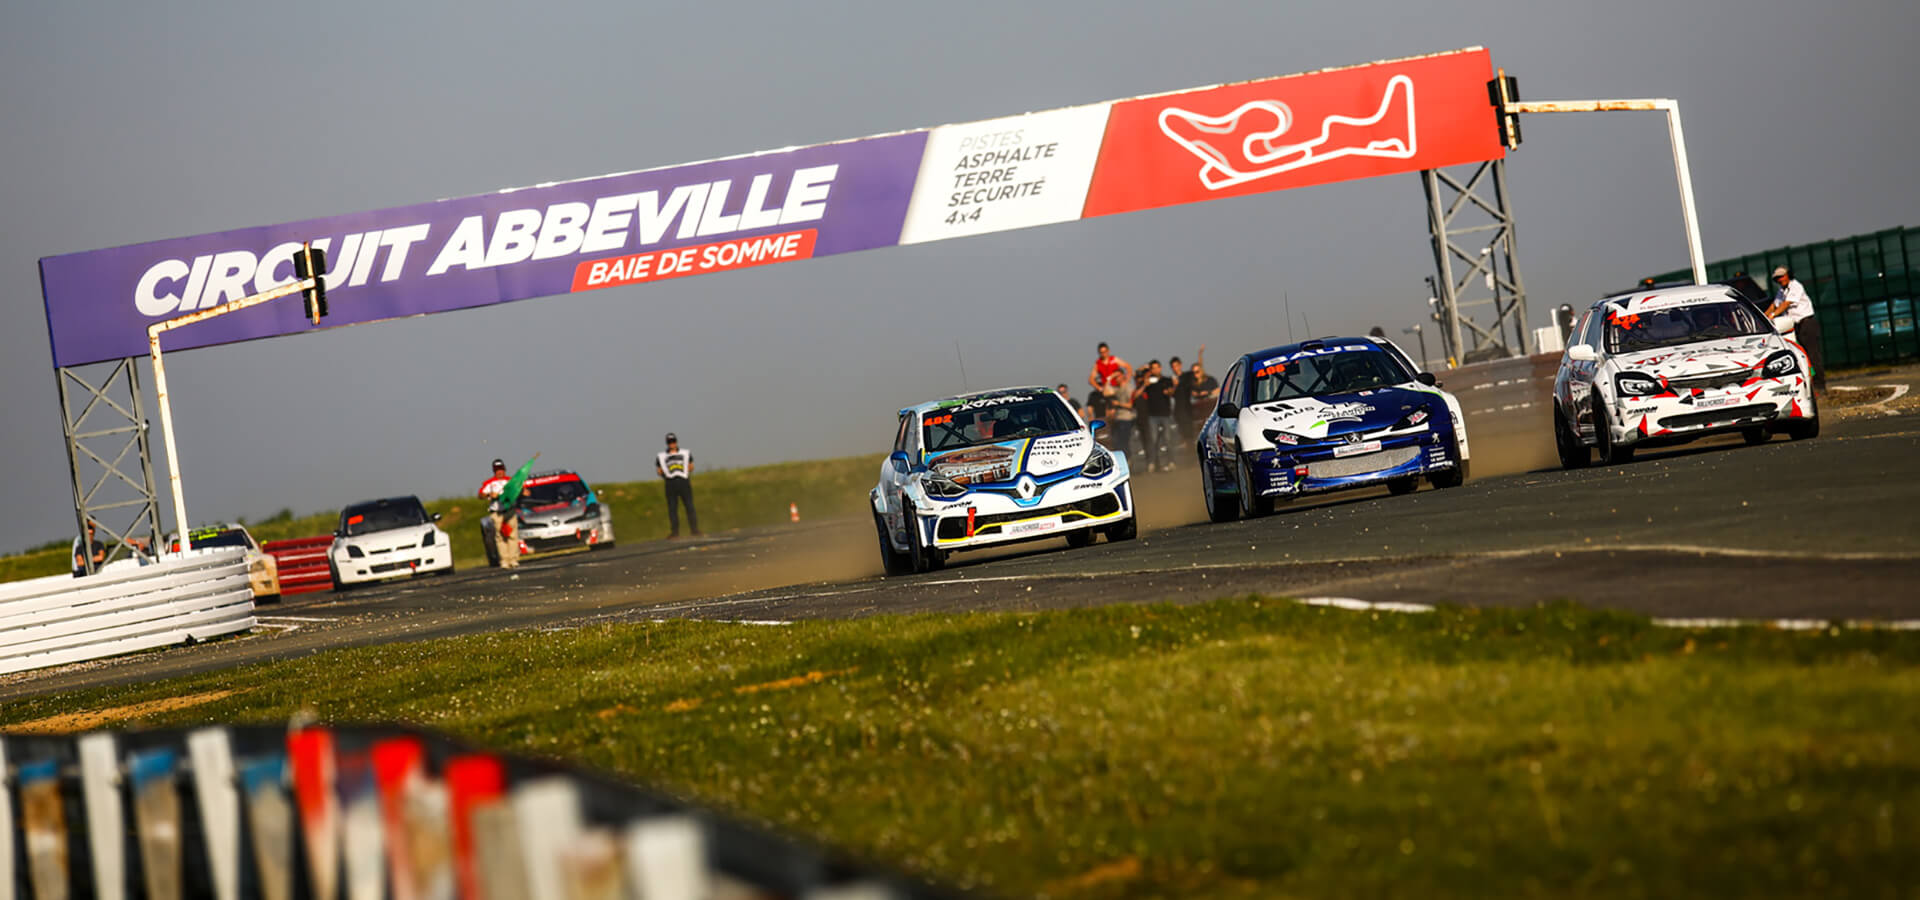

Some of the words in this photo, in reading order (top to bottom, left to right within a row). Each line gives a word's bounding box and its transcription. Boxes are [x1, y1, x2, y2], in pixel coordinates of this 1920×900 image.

[959, 129, 1025, 151] PISTES
[954, 142, 1059, 171] ASPHALTE
[954, 166, 1018, 188] TERRE
[944, 207, 983, 225] 4x4
[134, 223, 431, 317] CIRCUIT
[426, 164, 840, 277] ABBEVILLE
[586, 256, 654, 285] BAIE
[656, 249, 697, 276] DE
[699, 234, 803, 270] SOMME
